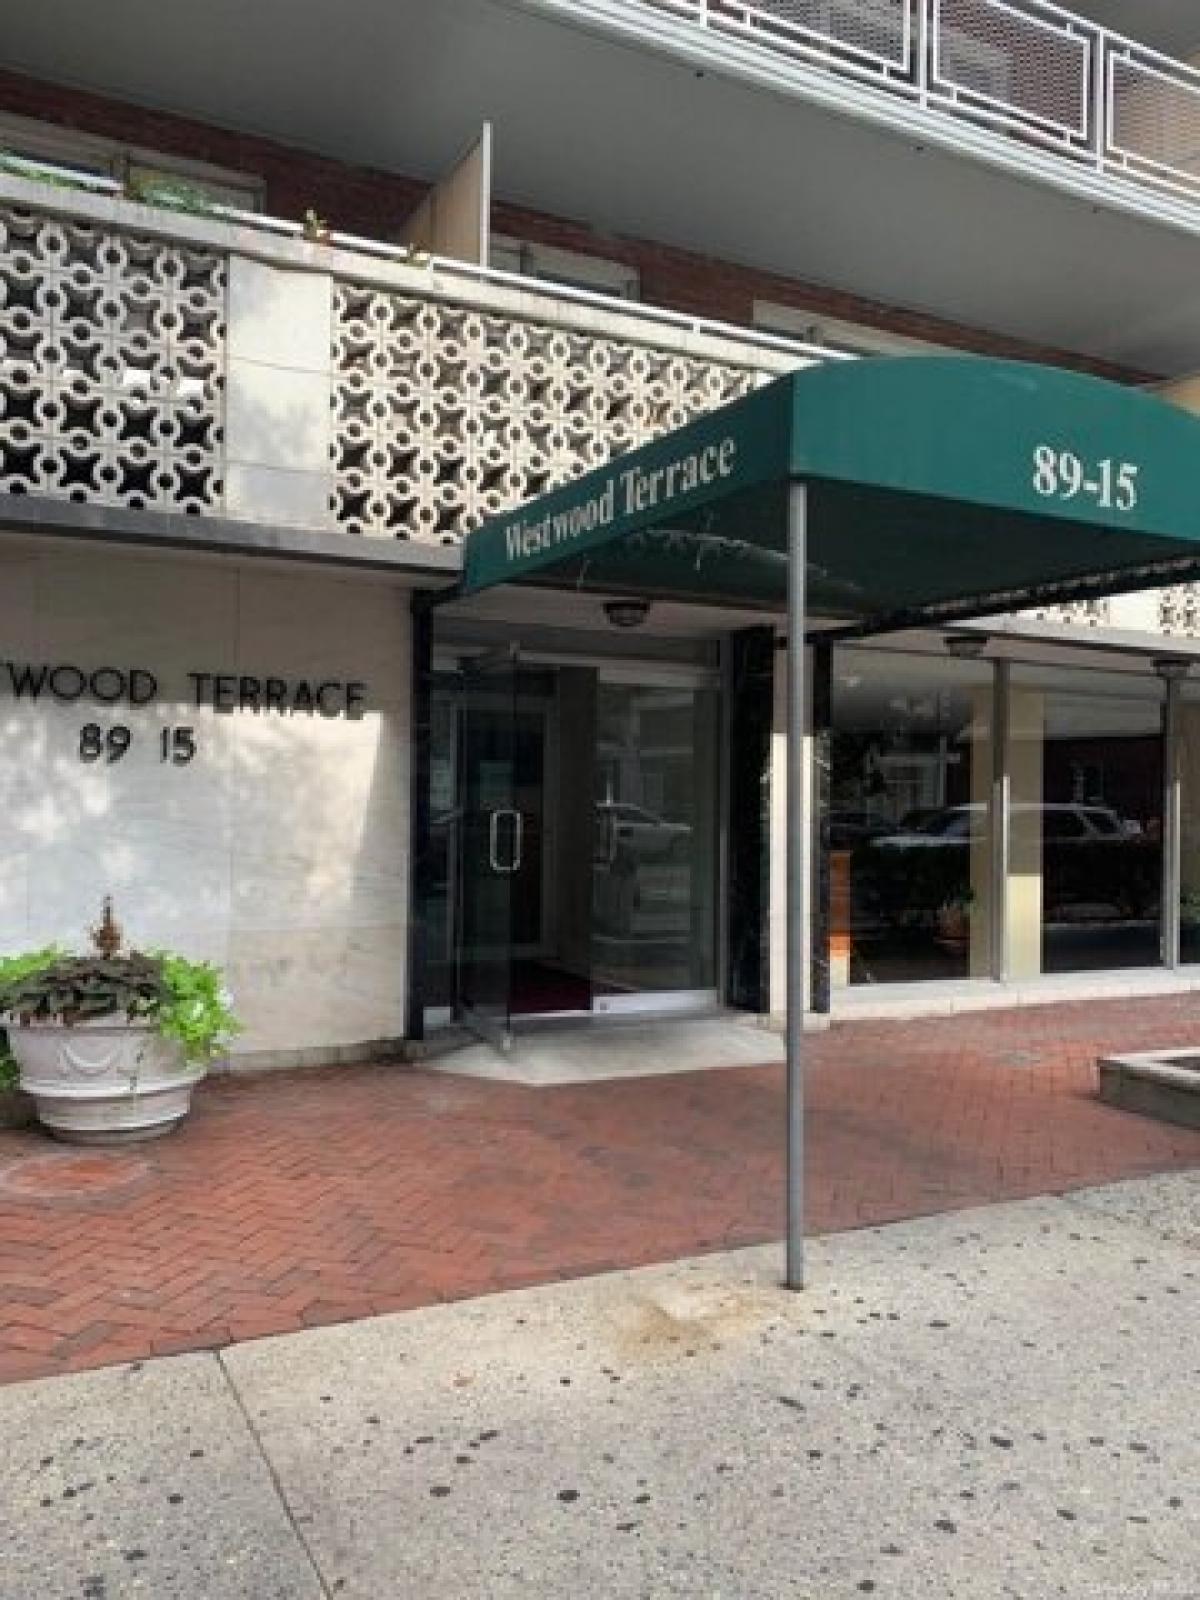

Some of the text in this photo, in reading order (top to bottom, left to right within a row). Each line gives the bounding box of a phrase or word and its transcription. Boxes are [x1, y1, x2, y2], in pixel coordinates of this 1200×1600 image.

[506, 437, 735, 561] Westwood Terrace
[1033, 444, 1138, 511] 89-15
[0, 662, 366, 719] WOOD TERRACE
[79, 723, 197, 766] 89 15
